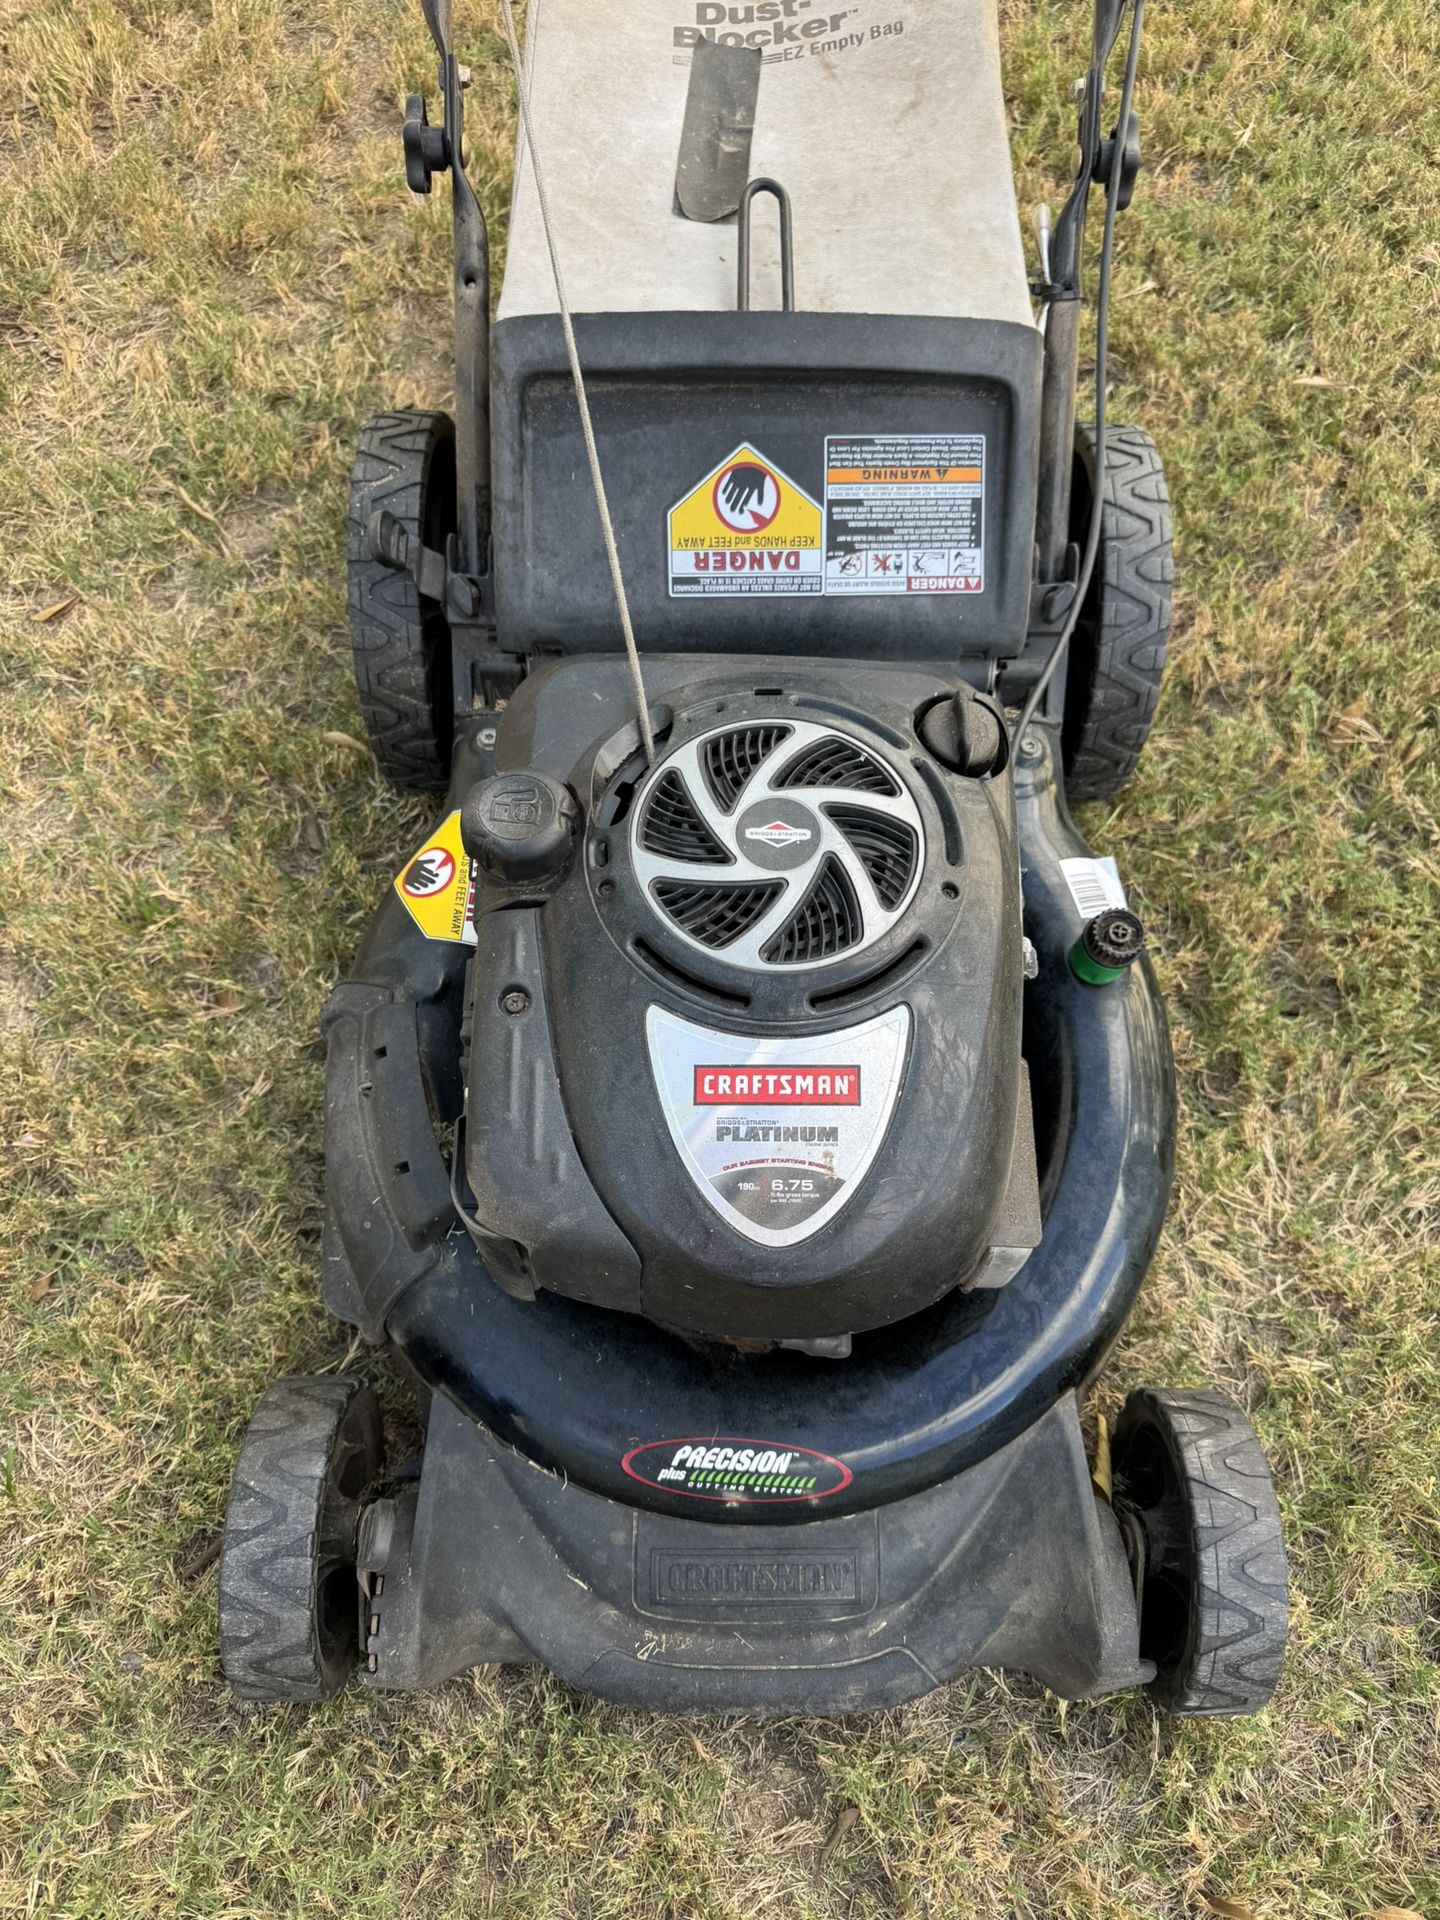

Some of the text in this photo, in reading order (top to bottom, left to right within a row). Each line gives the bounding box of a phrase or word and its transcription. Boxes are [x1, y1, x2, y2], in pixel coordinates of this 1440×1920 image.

[696, 0, 811, 25] Dust-
[783, 20, 904, 62] EZ Empty Bag
[862, 469, 931, 480] WARNING
[677, 536, 814, 548] KEEP HANDS and FEET AWAY
[694, 551, 800, 571] DANGER
[911, 577, 965, 589] DANGER
[458, 869, 467, 884] and
[454, 886, 466, 908] FEET
[450, 908, 463, 936] AWAY
[716, 1126, 838, 1142] PLATINUM
[722, 1162, 738, 1171] OUR
[771, 1158, 806, 1166] STARTING
[771, 1179, 813, 1191] 6.75
[657, 1466, 687, 1482] plus
[687, 1482, 803, 1495] CUTTING SYSTEM
